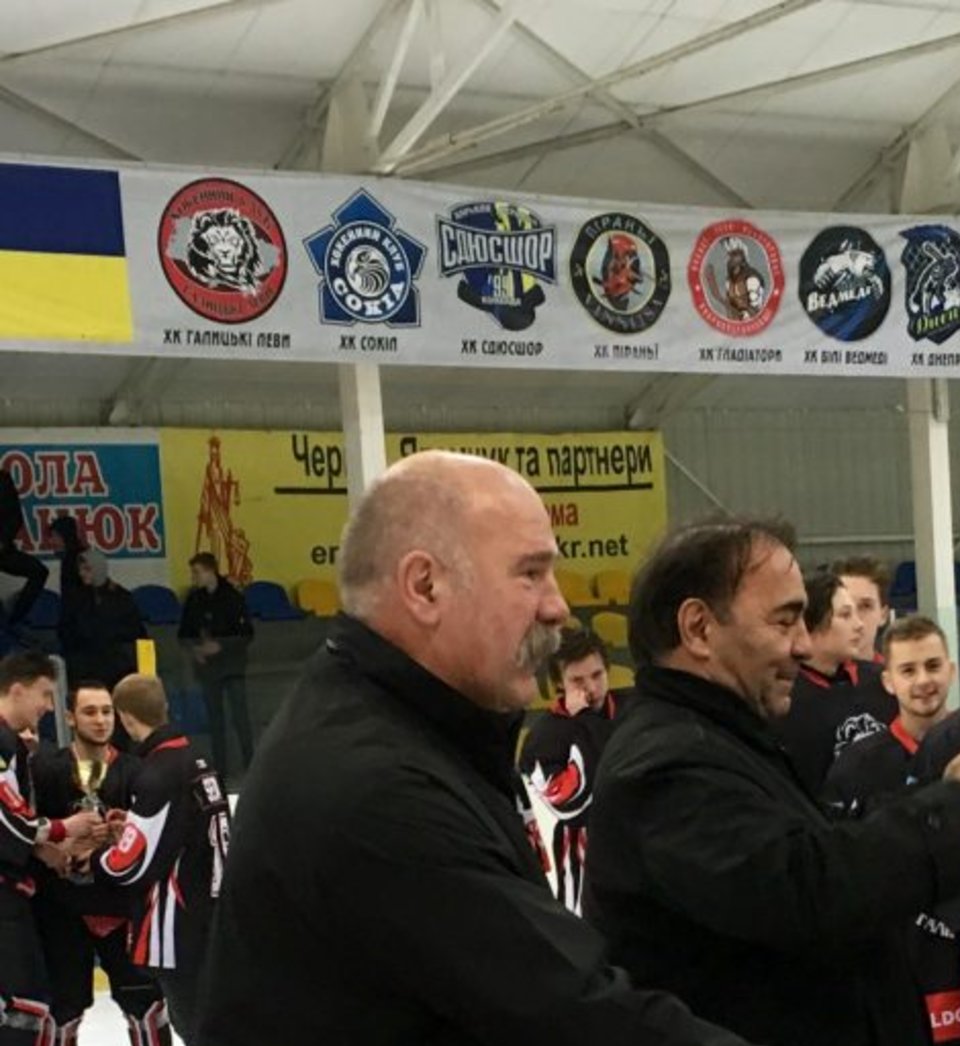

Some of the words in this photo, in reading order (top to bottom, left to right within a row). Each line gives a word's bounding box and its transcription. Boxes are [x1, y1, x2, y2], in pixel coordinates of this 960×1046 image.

[440, 224, 553, 272] СДЮСШОР
[163, 329, 181, 344] ХК
[186, 330, 252, 348] ГАЛИЦЬКІ
[256, 332, 291, 349] ЛЕВИ
[339, 335, 356, 350] ХК
[360, 335, 398, 352] СОКІЛ
[461, 339, 477, 355] ХК
[481, 340, 544, 357] СДЮСШОР
[594, 344, 610, 359] ХК
[699, 347, 714, 362] ХК
[804, 350, 818, 364] ХК
[911, 353, 924, 366] ХК
[291, 433, 347, 488] Чер
[547, 443, 653, 487] партнери
[545, 502, 579, 529] ма
